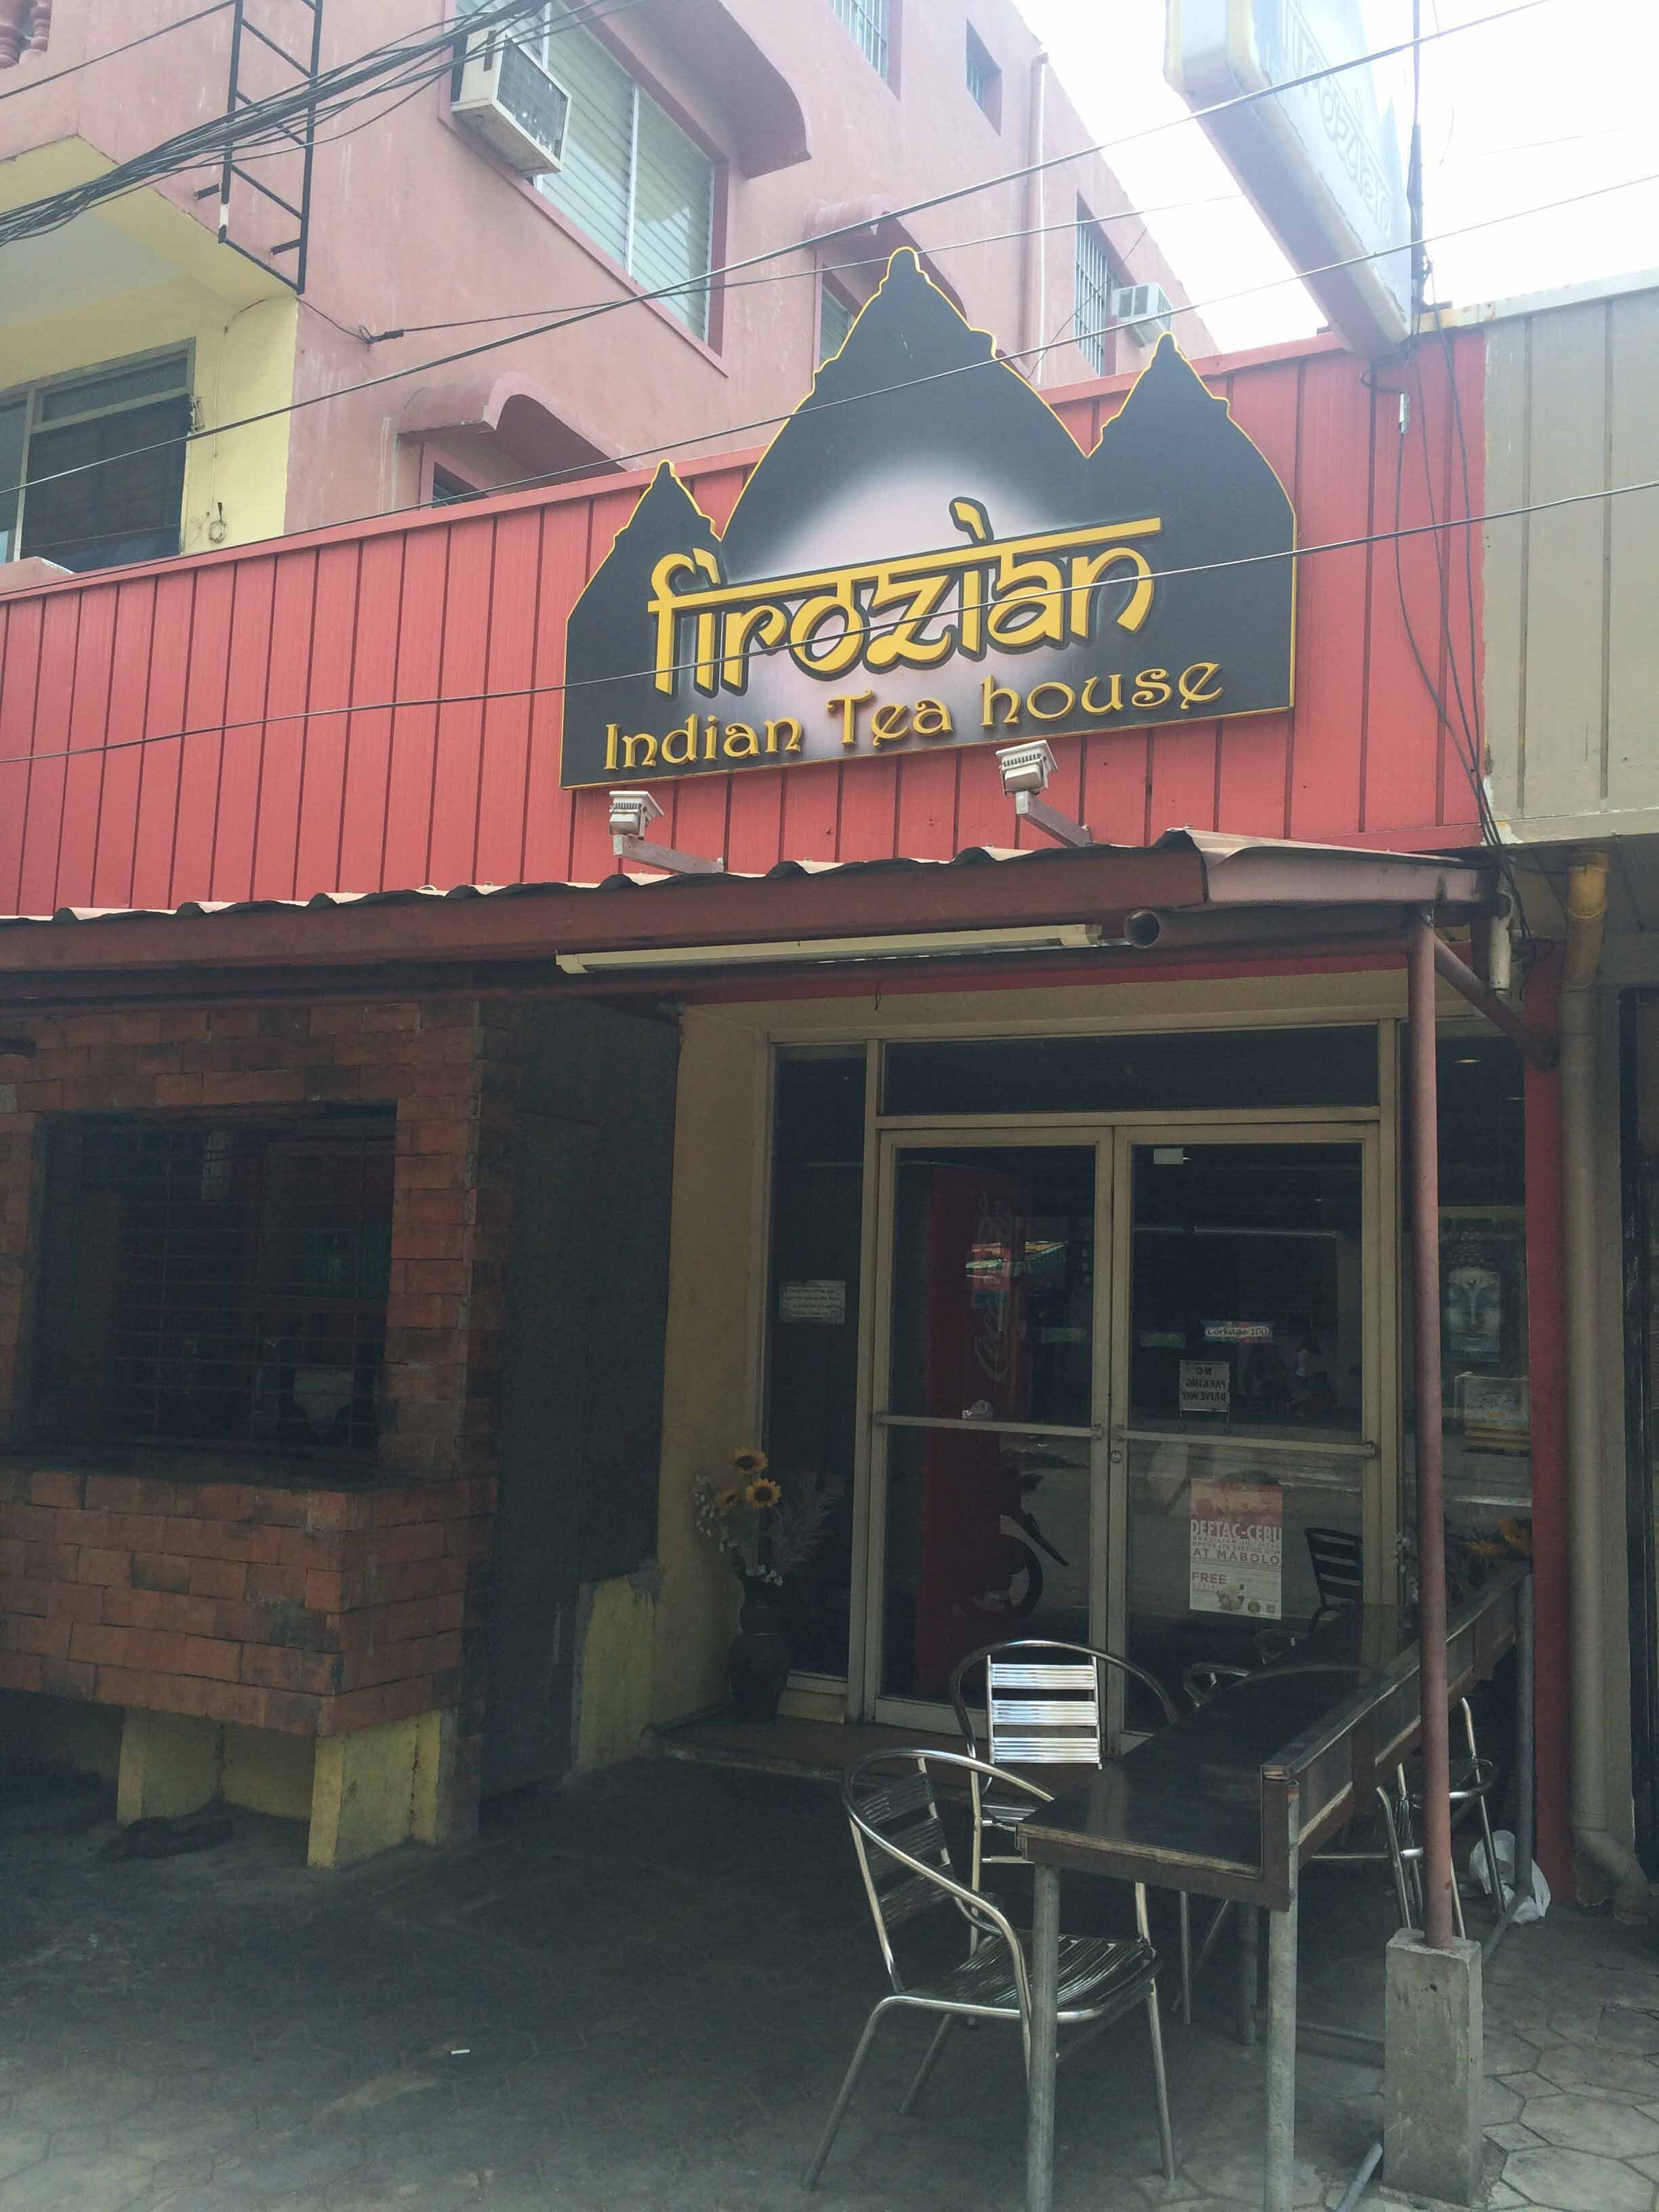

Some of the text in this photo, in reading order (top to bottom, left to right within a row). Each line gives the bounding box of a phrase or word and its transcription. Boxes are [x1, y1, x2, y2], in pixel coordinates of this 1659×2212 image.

[647, 500, 1162, 696] firozian
[604, 662, 1224, 770] Indian Tea house
[1192, 1572, 1226, 1584] FREE
[1193, 1548, 1209, 1557] AT
[1217, 1549, 1280, 1565] MABOLO
